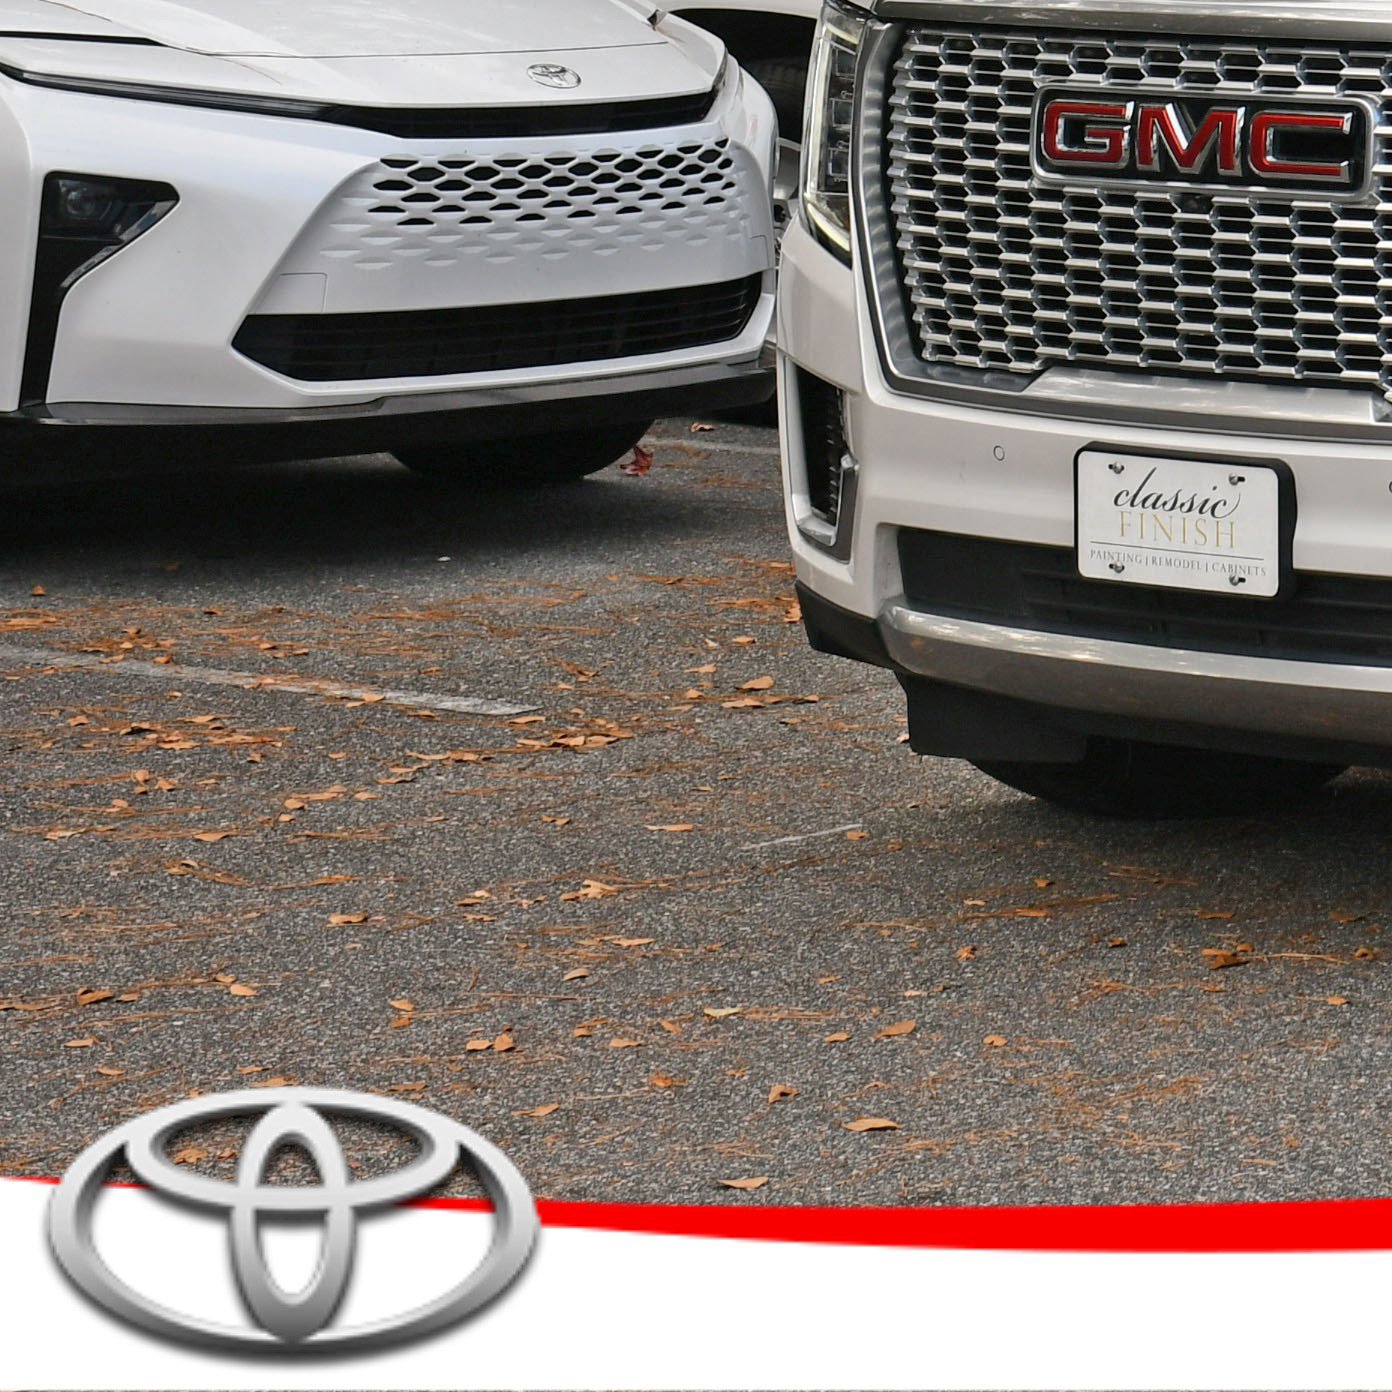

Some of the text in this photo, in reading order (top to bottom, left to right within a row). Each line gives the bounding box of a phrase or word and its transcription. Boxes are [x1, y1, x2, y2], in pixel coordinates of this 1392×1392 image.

[1041, 97, 1353, 183] GMC
[1113, 466, 1241, 519] classic
[1119, 510, 1237, 549] FINISH
[1090, 549, 1267, 577] PAINTING REMODEL CABINETS
